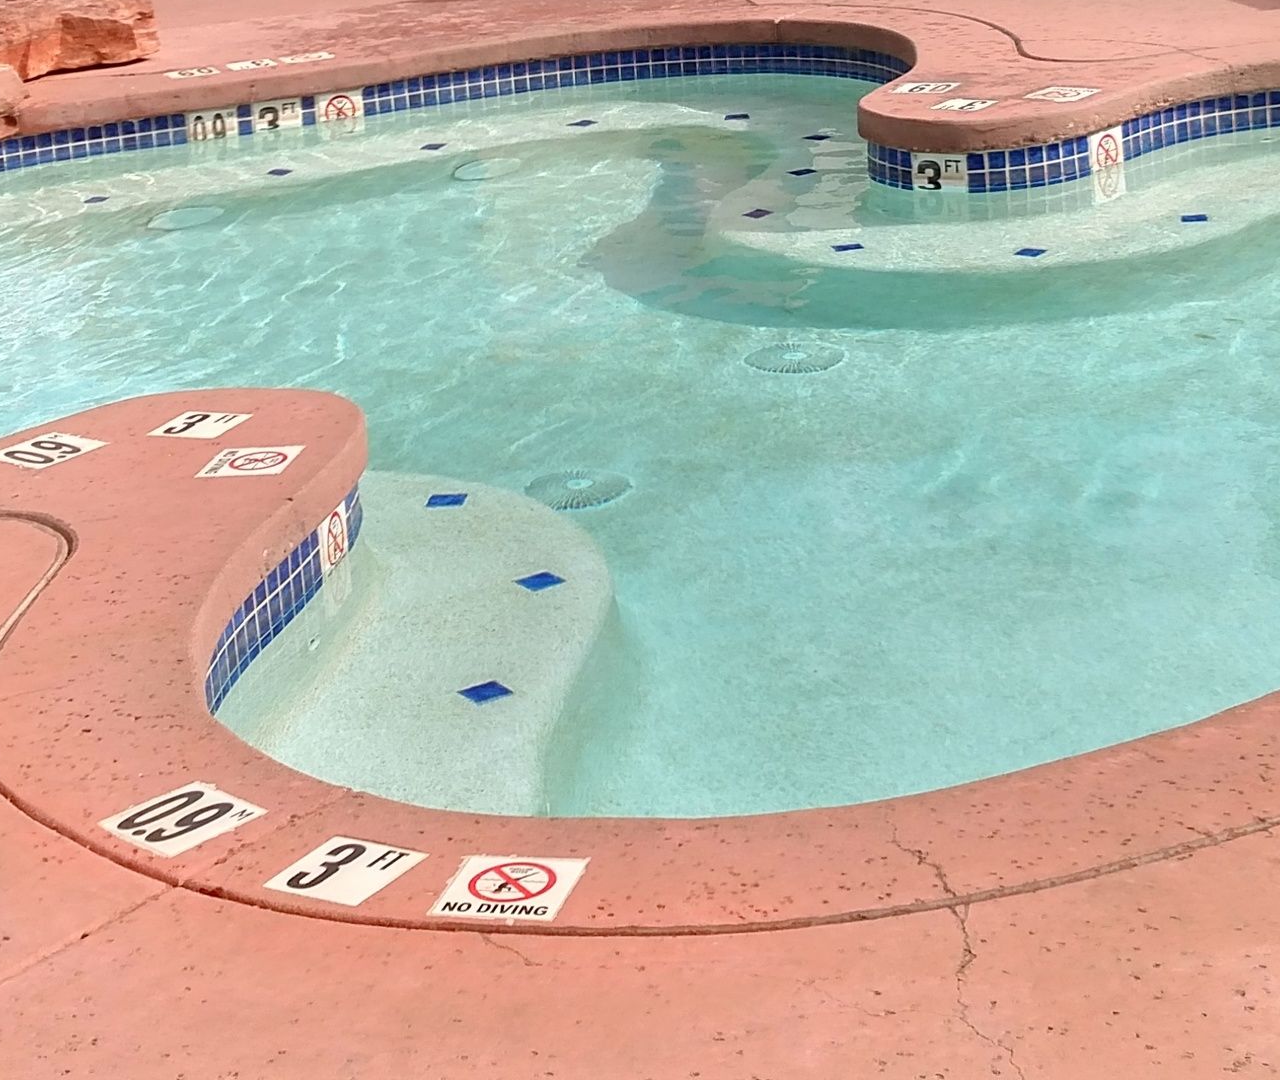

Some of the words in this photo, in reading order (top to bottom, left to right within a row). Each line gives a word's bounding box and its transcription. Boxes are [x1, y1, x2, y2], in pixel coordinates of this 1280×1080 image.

[281, 102, 297, 115] FT
[917, 159, 942, 191] 3
[944, 159, 961, 174] FT
[163, 413, 212, 435] 3
[4, 440, 83, 465] 0.9
[116, 789, 236, 844] 0.9
[230, 808, 254, 821] M
[286, 842, 368, 891] 3
[367, 849, 412, 871] FT
[441, 901, 472, 913] NO
[476, 903, 549, 917] DIVING
